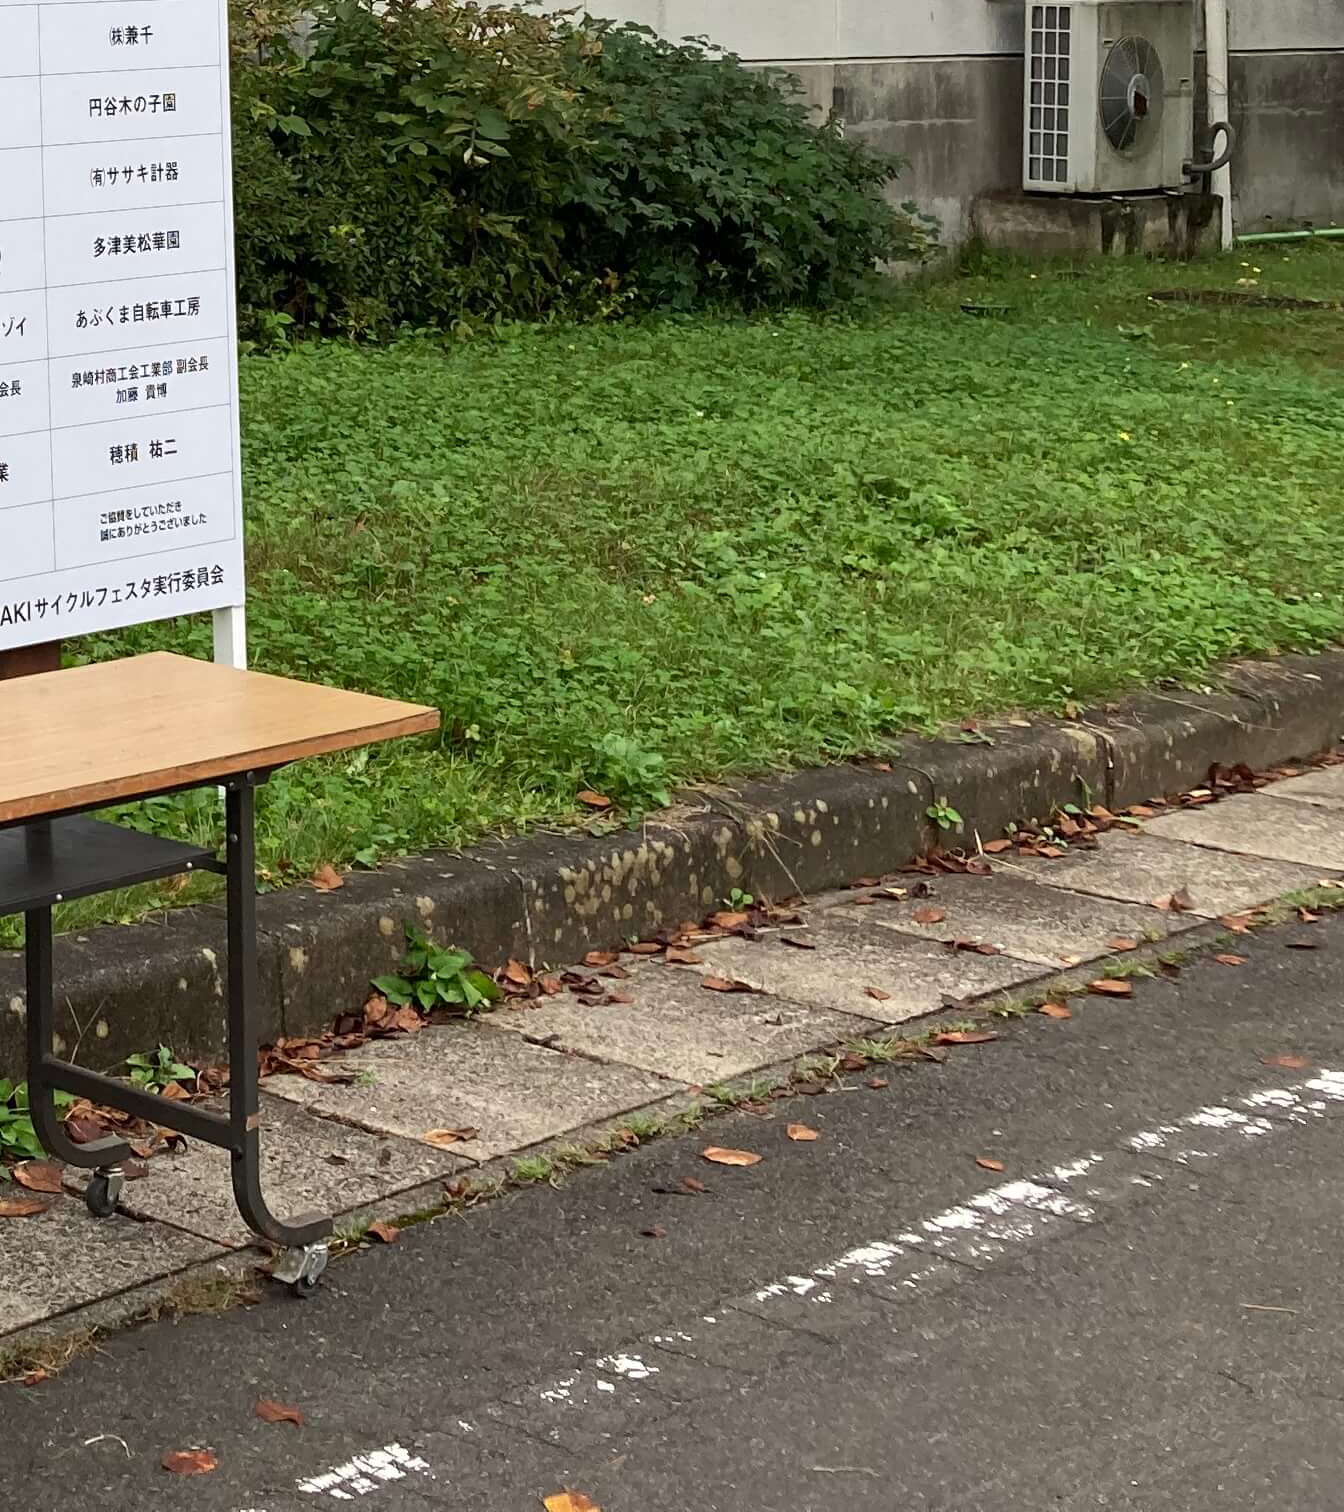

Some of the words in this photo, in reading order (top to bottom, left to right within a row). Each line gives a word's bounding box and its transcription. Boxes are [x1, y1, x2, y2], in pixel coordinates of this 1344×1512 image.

[75, 295, 201, 329] あぶくま自転車工房
